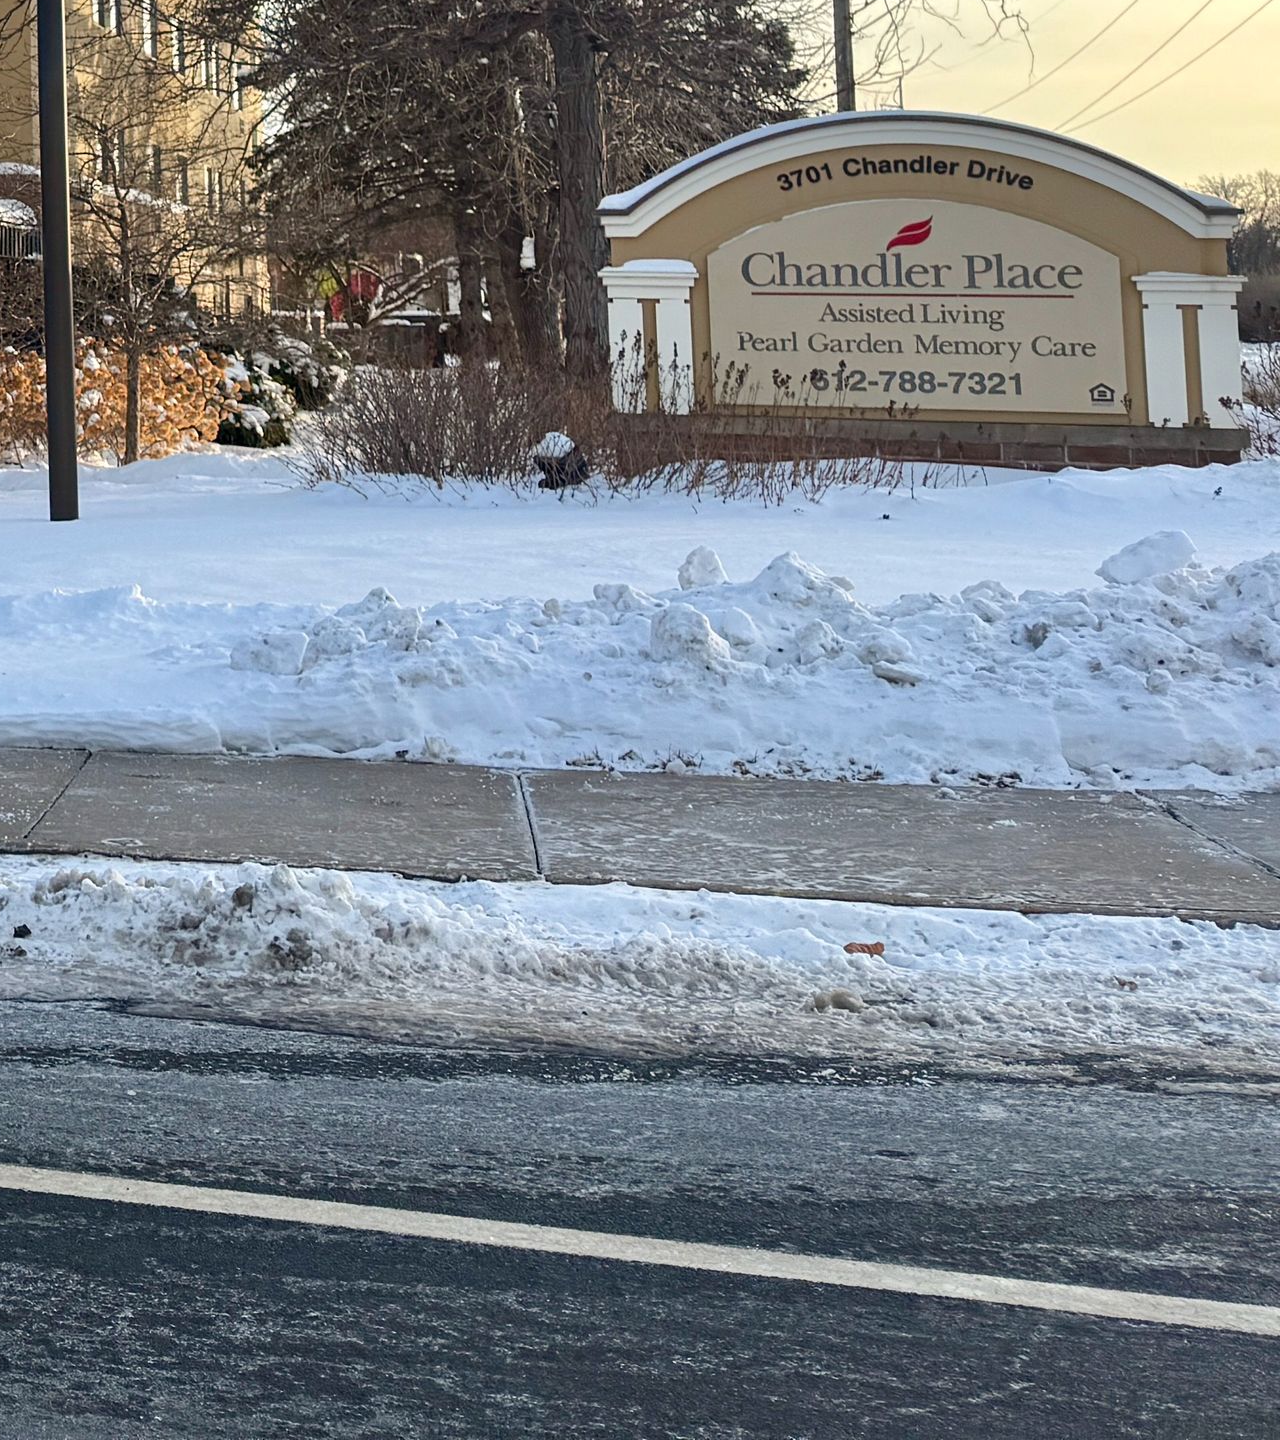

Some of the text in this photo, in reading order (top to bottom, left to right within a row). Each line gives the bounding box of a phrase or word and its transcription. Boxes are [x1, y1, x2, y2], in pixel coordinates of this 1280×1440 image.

[776, 155, 1034, 191] 3701 Chandler Drive
[741, 251, 1083, 290] Chandler Place
[818, 302, 1005, 331] Assisted Living
[736, 331, 1097, 363] Pearl Garden Memory Care
[810, 369, 1022, 395] 612-788-7321
